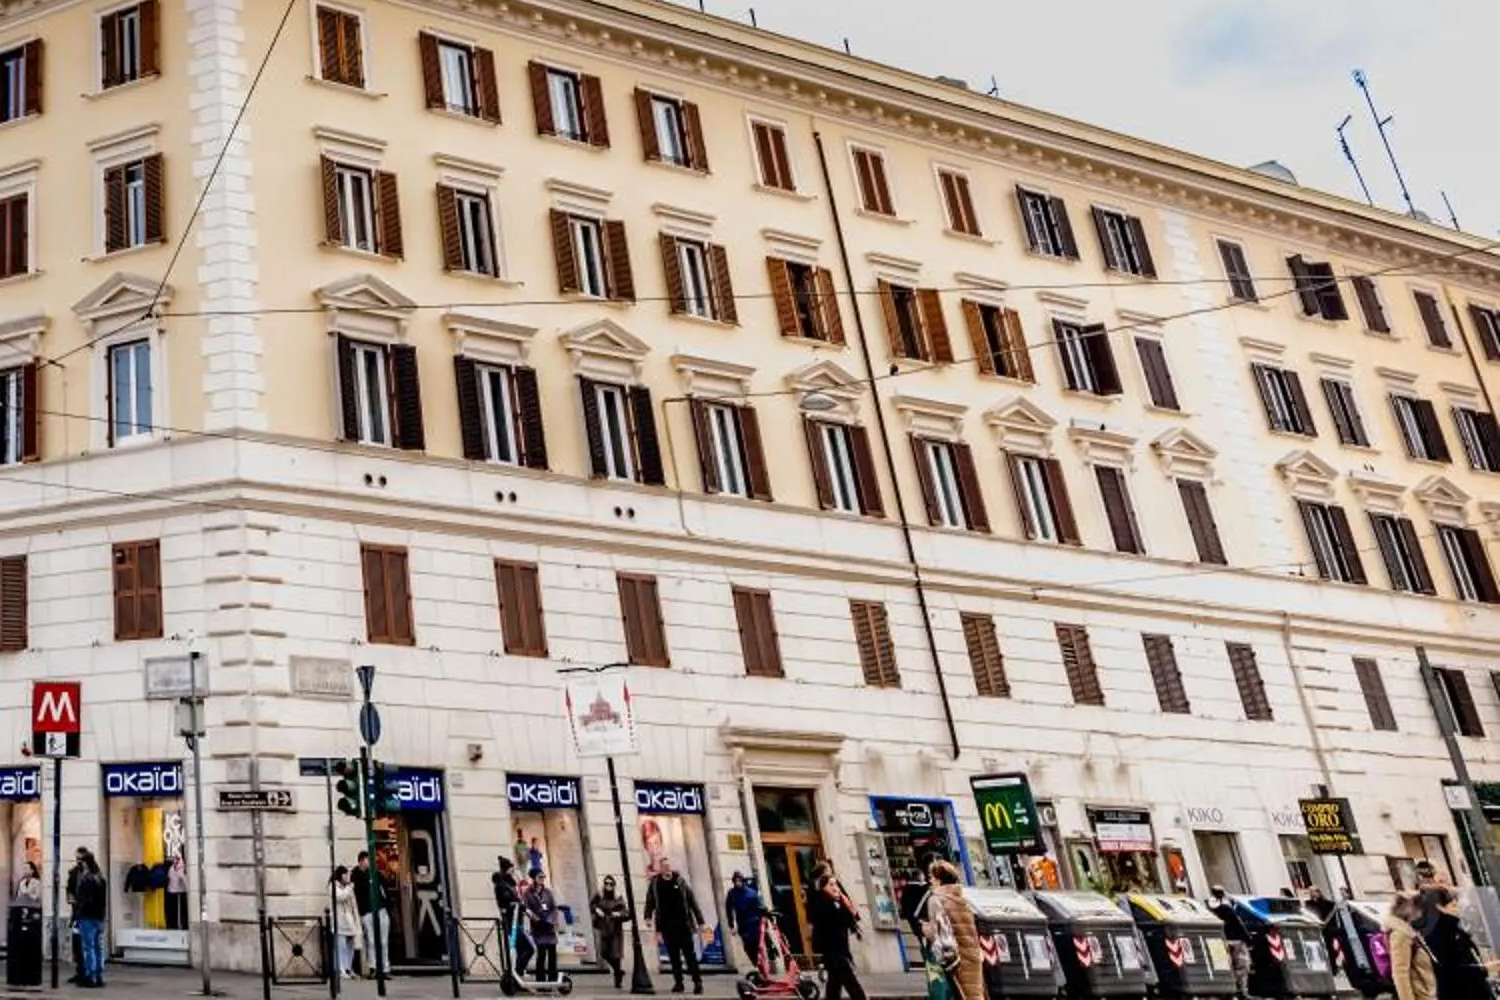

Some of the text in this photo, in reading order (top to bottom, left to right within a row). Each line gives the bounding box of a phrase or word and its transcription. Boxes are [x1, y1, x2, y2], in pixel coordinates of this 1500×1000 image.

[38, 691, 77, 722] M
[107, 767, 183, 791] okaïdi
[507, 780, 578, 805] okaïdi
[635, 786, 702, 811] okaïdi
[1187, 807, 1224, 824] KIKO
[1308, 812, 1339, 827] ORO
